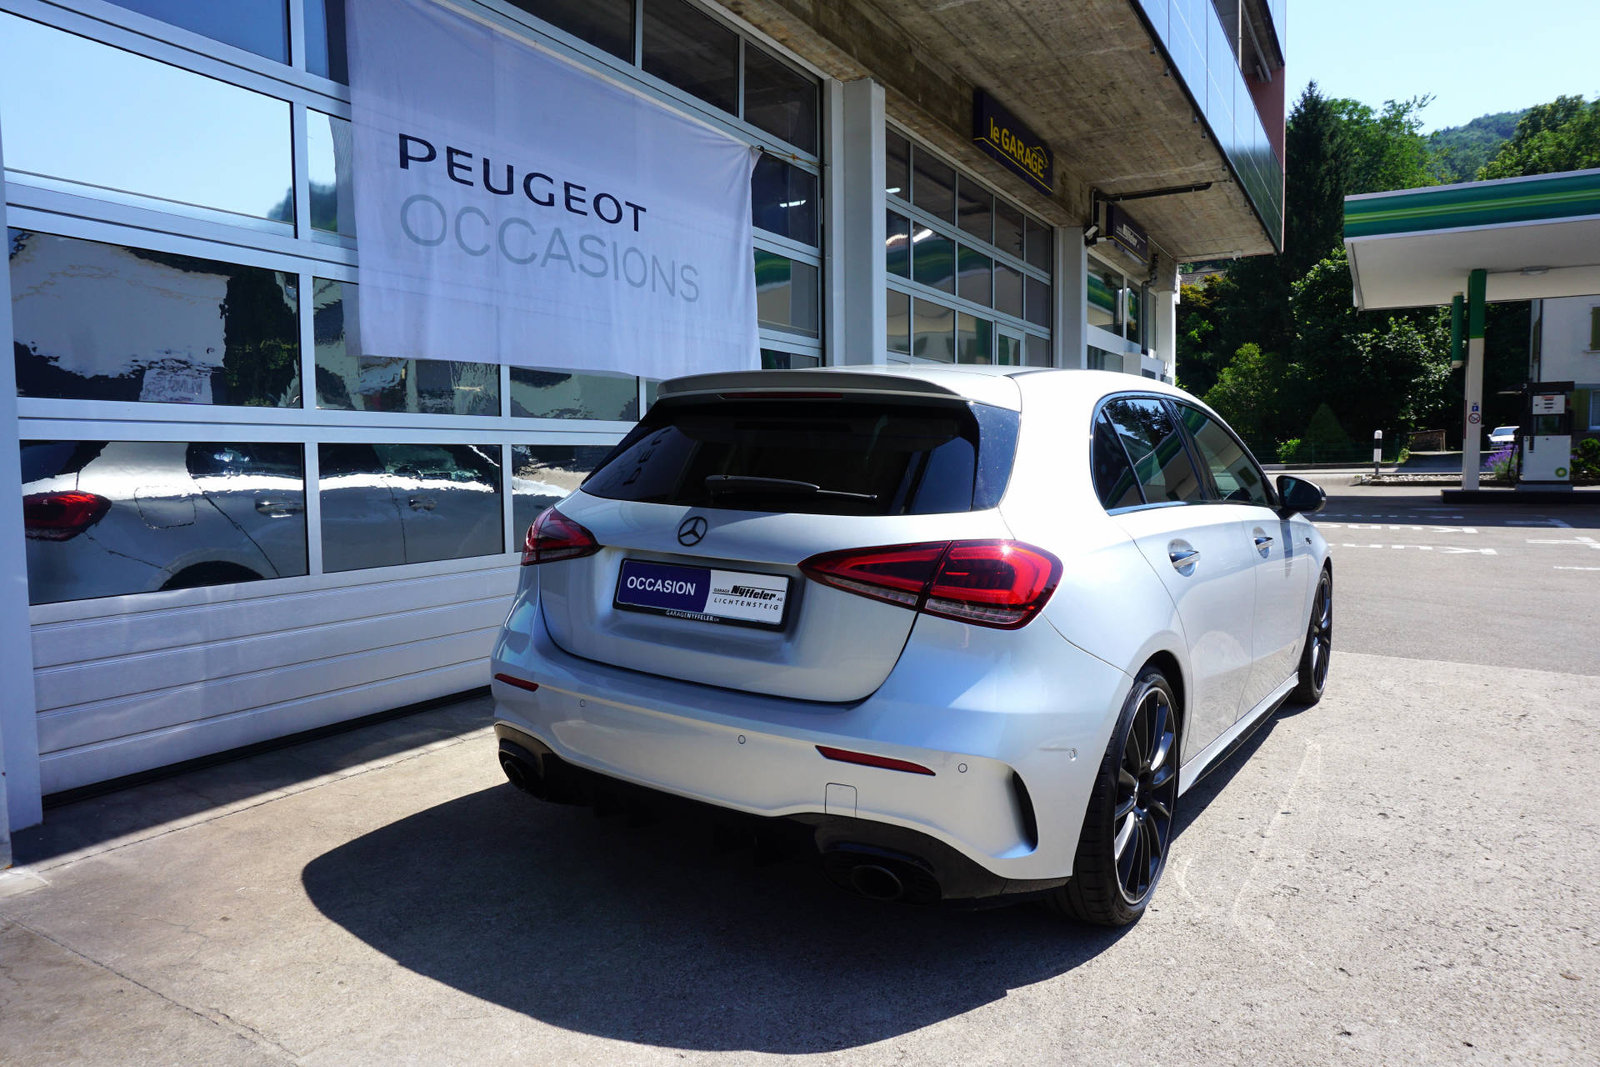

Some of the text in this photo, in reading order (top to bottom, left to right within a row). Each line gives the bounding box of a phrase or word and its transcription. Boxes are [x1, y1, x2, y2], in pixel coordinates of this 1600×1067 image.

[989, 116, 1045, 179] le GARAGE
[398, 133, 647, 232] PEUGEOT
[400, 194, 700, 303] OCCASIONS
[626, 576, 696, 596] OCCASION
[713, 597, 779, 611] LICHTENSTEIG
[730, 585, 777, 601] Nyffeler
